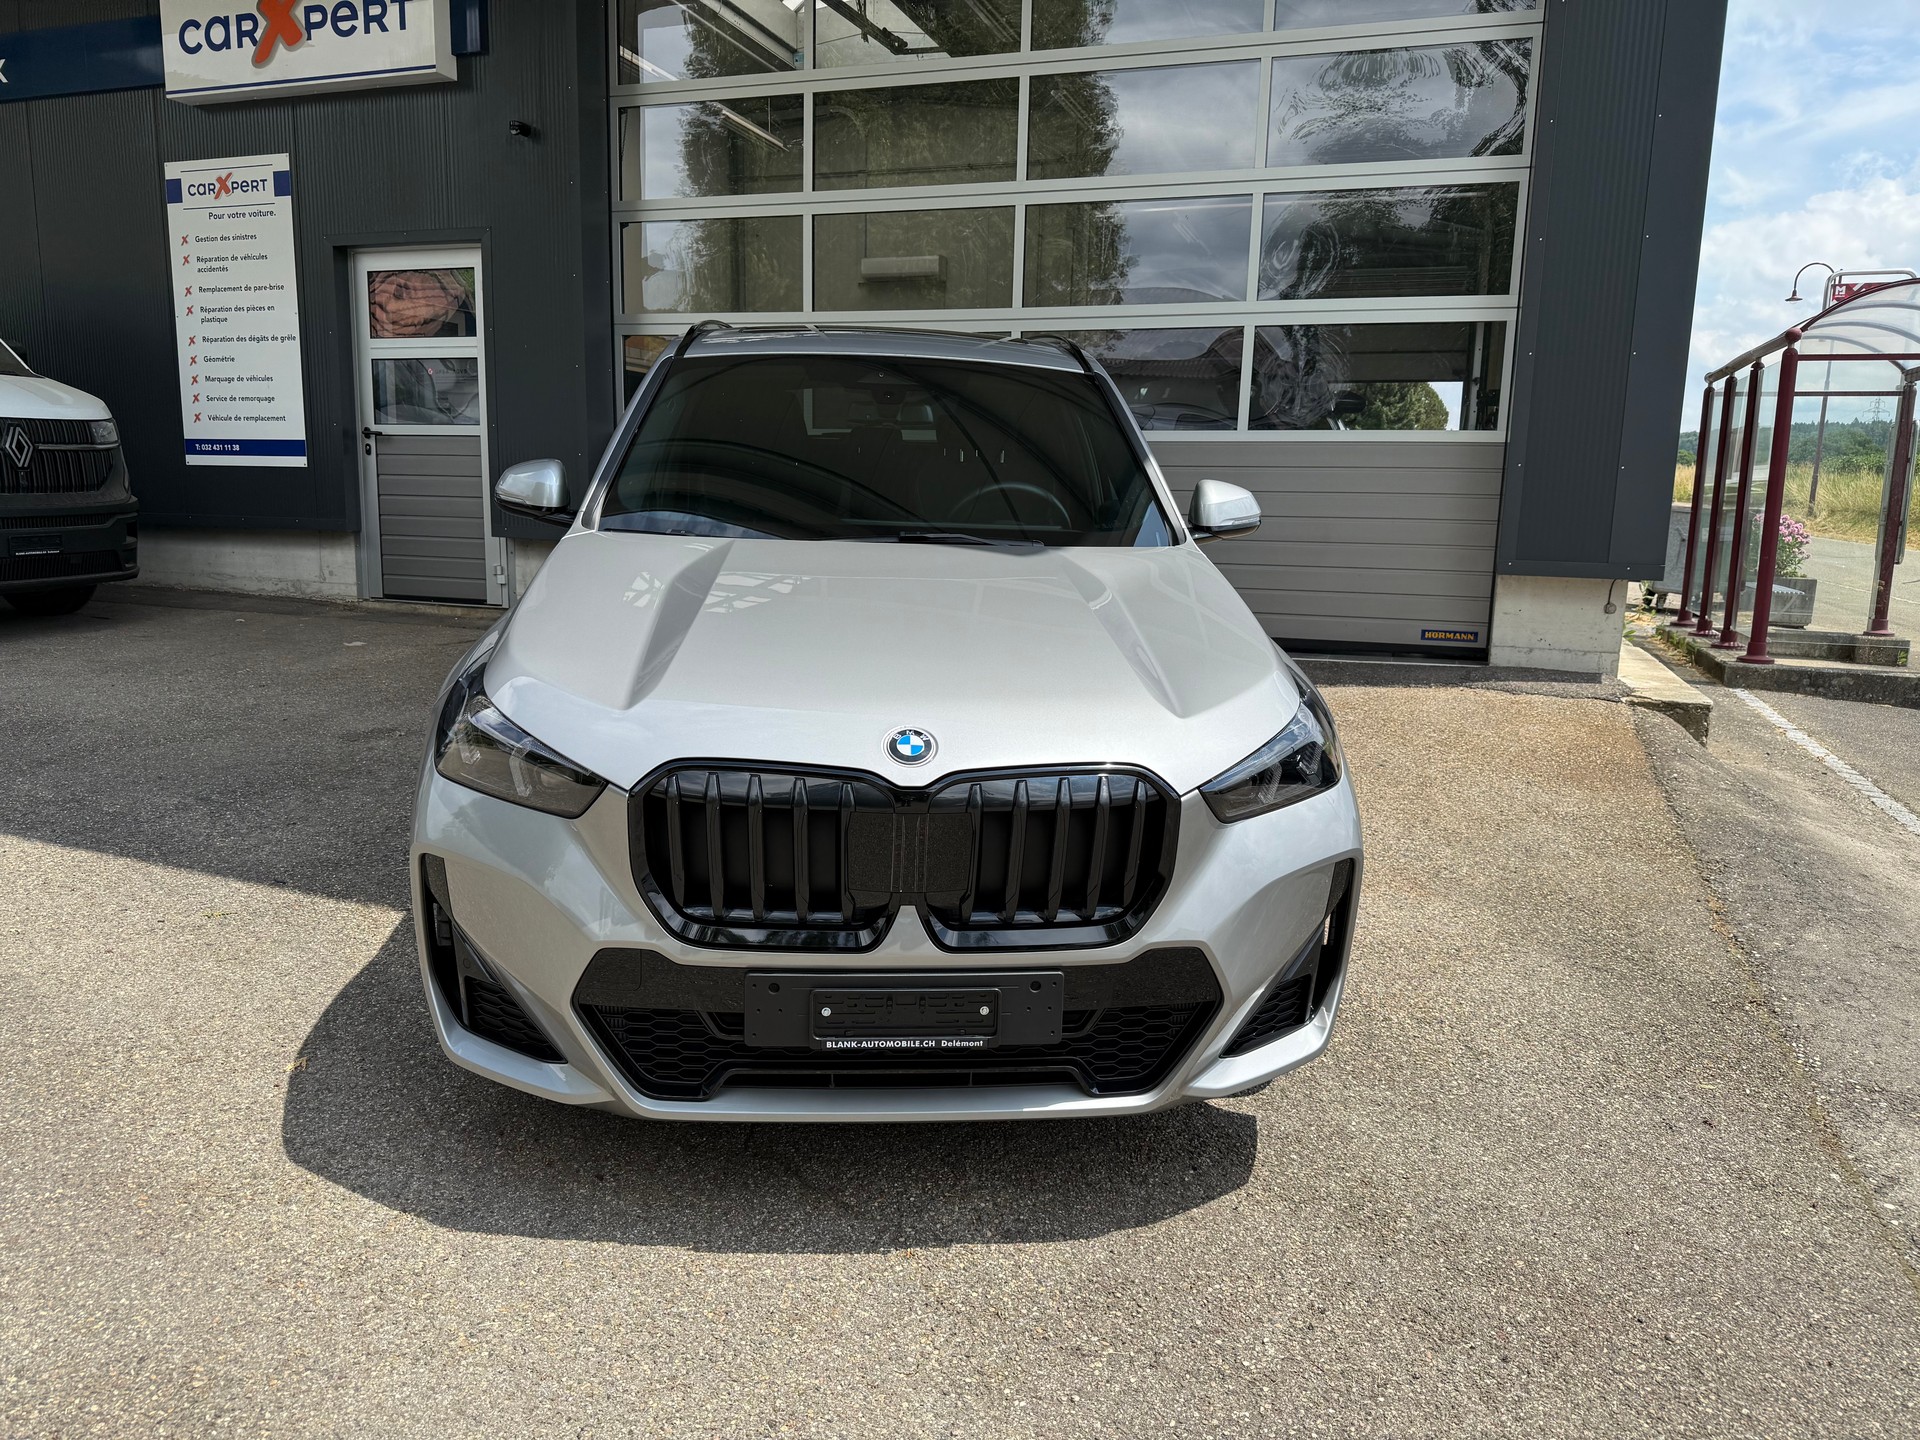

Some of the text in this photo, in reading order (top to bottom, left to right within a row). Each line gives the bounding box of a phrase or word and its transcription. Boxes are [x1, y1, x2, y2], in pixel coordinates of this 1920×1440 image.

[208, 209, 277, 220] Pour votre voiture.
[195, 233, 257, 243] Gestion des sinistres
[196, 252, 268, 264] Réparation de véhicules
[197, 265, 229, 273] accidentés
[198, 283, 285, 294] Remplacement de pare-brise
[200, 305, 233, 314] Réparation
[246, 304, 266, 313] pièces
[201, 316, 228, 324] plastique
[202, 335, 235, 344] Réparation
[248, 335, 270, 343] dégâts
[271, 334, 279, 342] de
[280, 334, 297, 343] grêle
[203, 355, 235, 363] Géométrie
[204, 375, 235, 384] Marquage
[245, 374, 274, 382] véhicules
[238, 395, 275, 403] remorquage
[207, 414, 286, 423] Véhicule de remplacement
[893, 730, 930, 741] BMW
[826, 1039, 984, 1049] BLANK-AUTOMOBILE.CH Delémont
